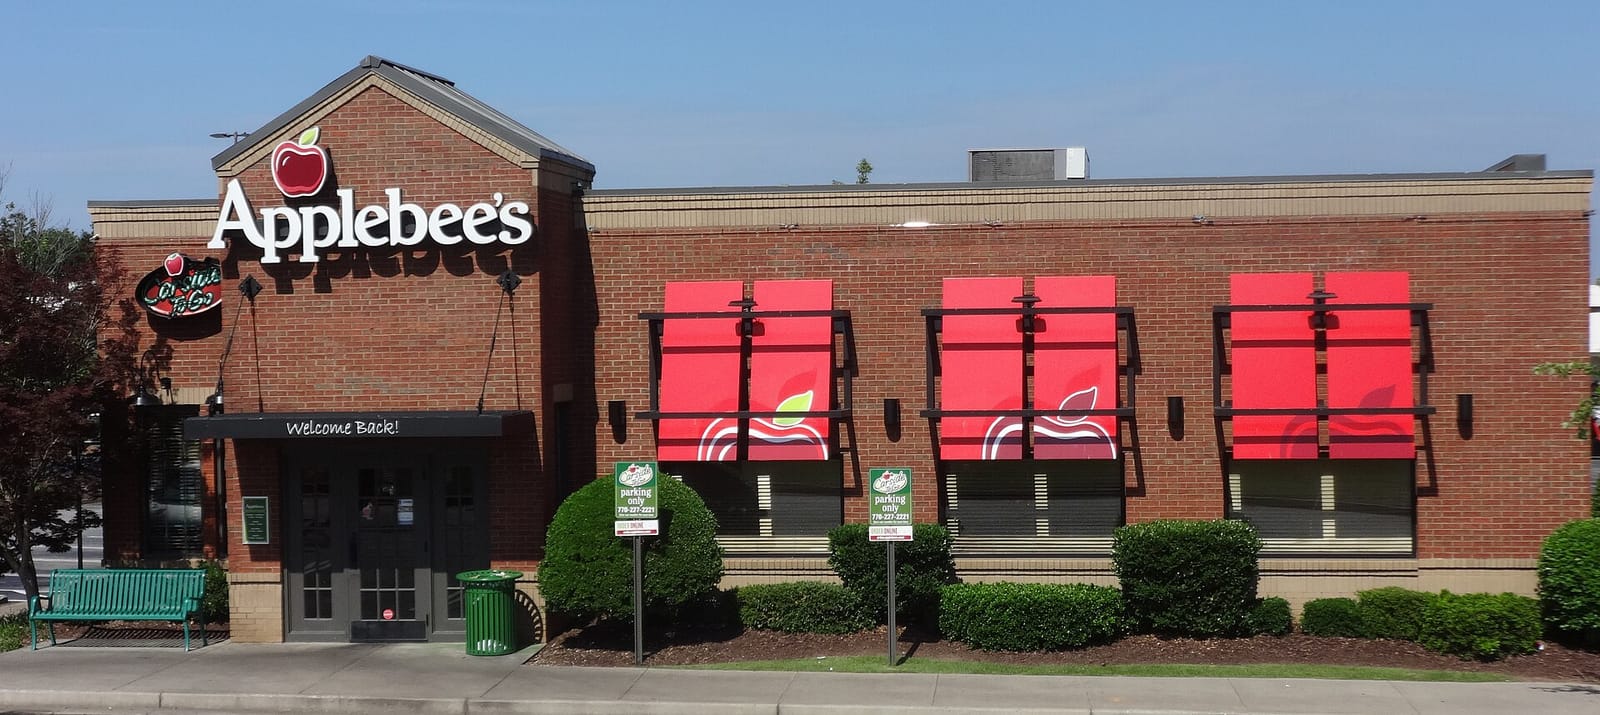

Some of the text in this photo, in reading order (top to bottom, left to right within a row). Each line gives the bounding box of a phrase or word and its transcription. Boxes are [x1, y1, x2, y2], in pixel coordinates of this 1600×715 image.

[207, 178, 533, 263] Applebee's
[188, 289, 213, 311] Go
[286, 419, 399, 436] Welcome Back!
[620, 488, 652, 498] parking
[627, 496, 645, 507] only
[875, 495, 906, 505] parking
[882, 503, 899, 513] only
